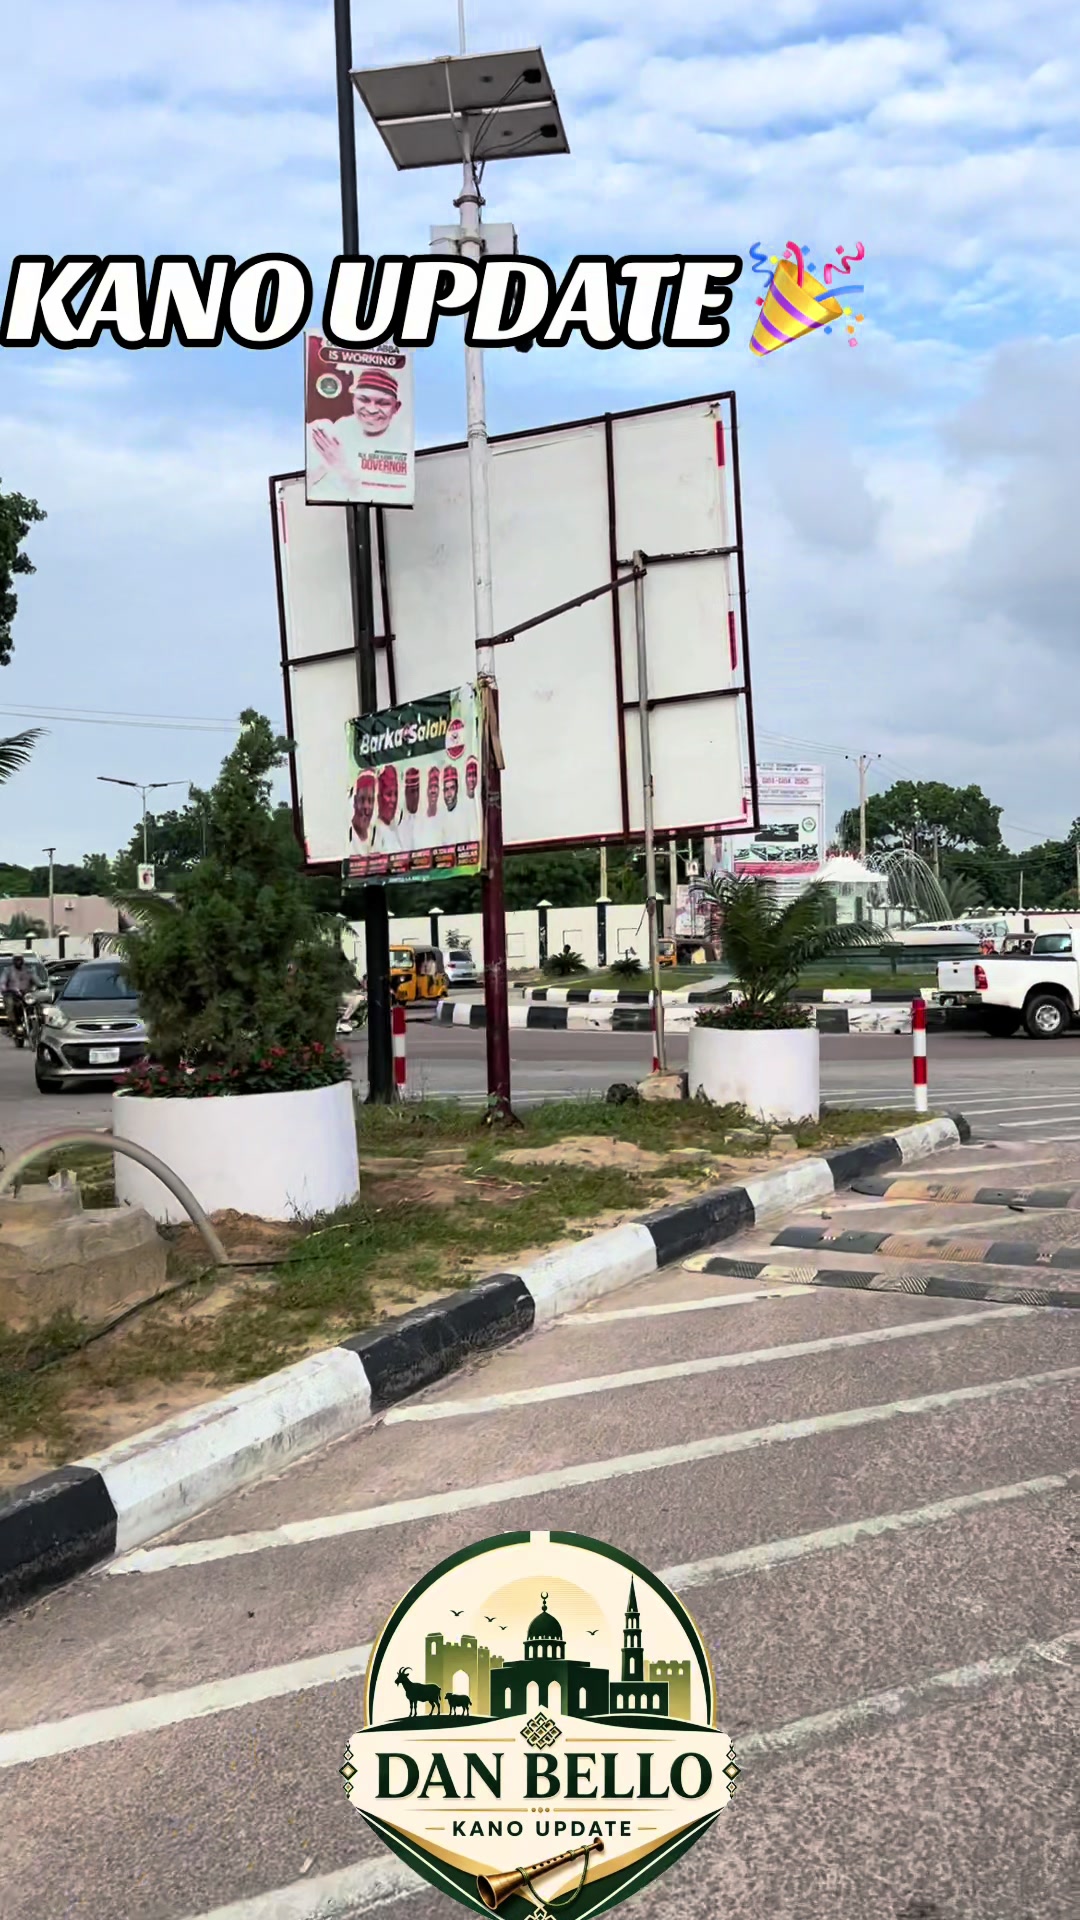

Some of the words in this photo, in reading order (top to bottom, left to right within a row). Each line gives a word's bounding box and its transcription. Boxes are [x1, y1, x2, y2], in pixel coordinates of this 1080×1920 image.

[328, 350, 339, 360] IS
[341, 351, 397, 366] WORKING
[361, 459, 407, 474] GOVERNOR
[359, 726, 404, 756] Barka
[406, 716, 447, 744] Salah
